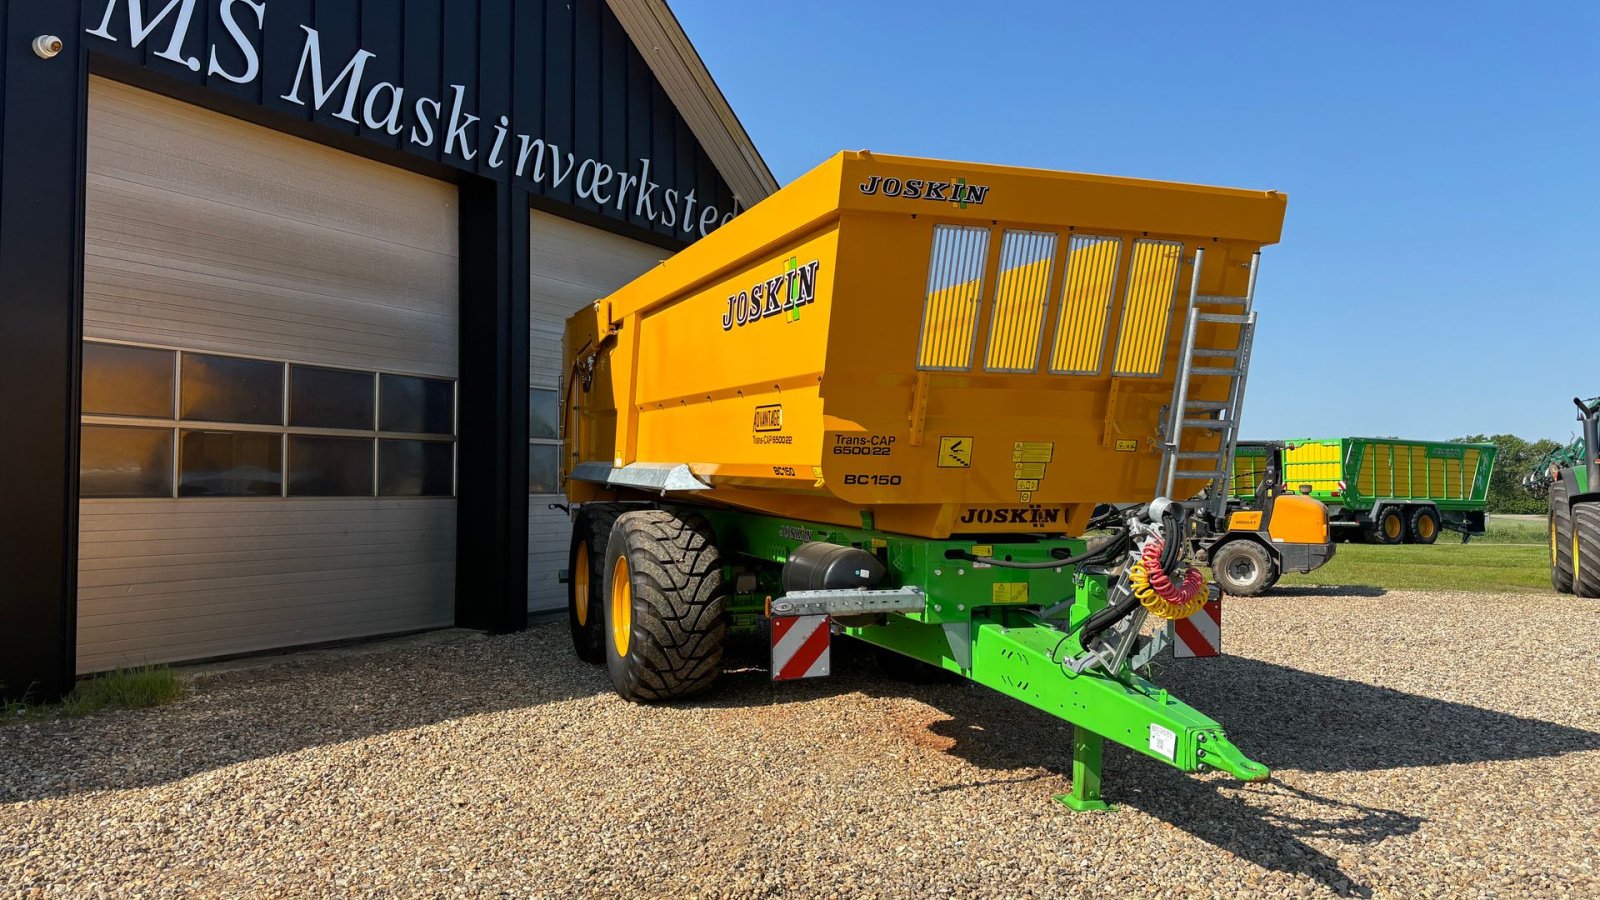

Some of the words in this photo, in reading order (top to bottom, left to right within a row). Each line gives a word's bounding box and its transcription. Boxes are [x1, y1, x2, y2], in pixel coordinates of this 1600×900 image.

[85, 0, 266, 84] M.S
[859, 175, 989, 204] JOSKIN
[722, 259, 819, 331] JOSKIN
[833, 446, 871, 455] 6500
[872, 447, 890, 456] 22
[835, 434, 896, 446] Trans-CAP
[960, 507, 1060, 525] JOSKIN
